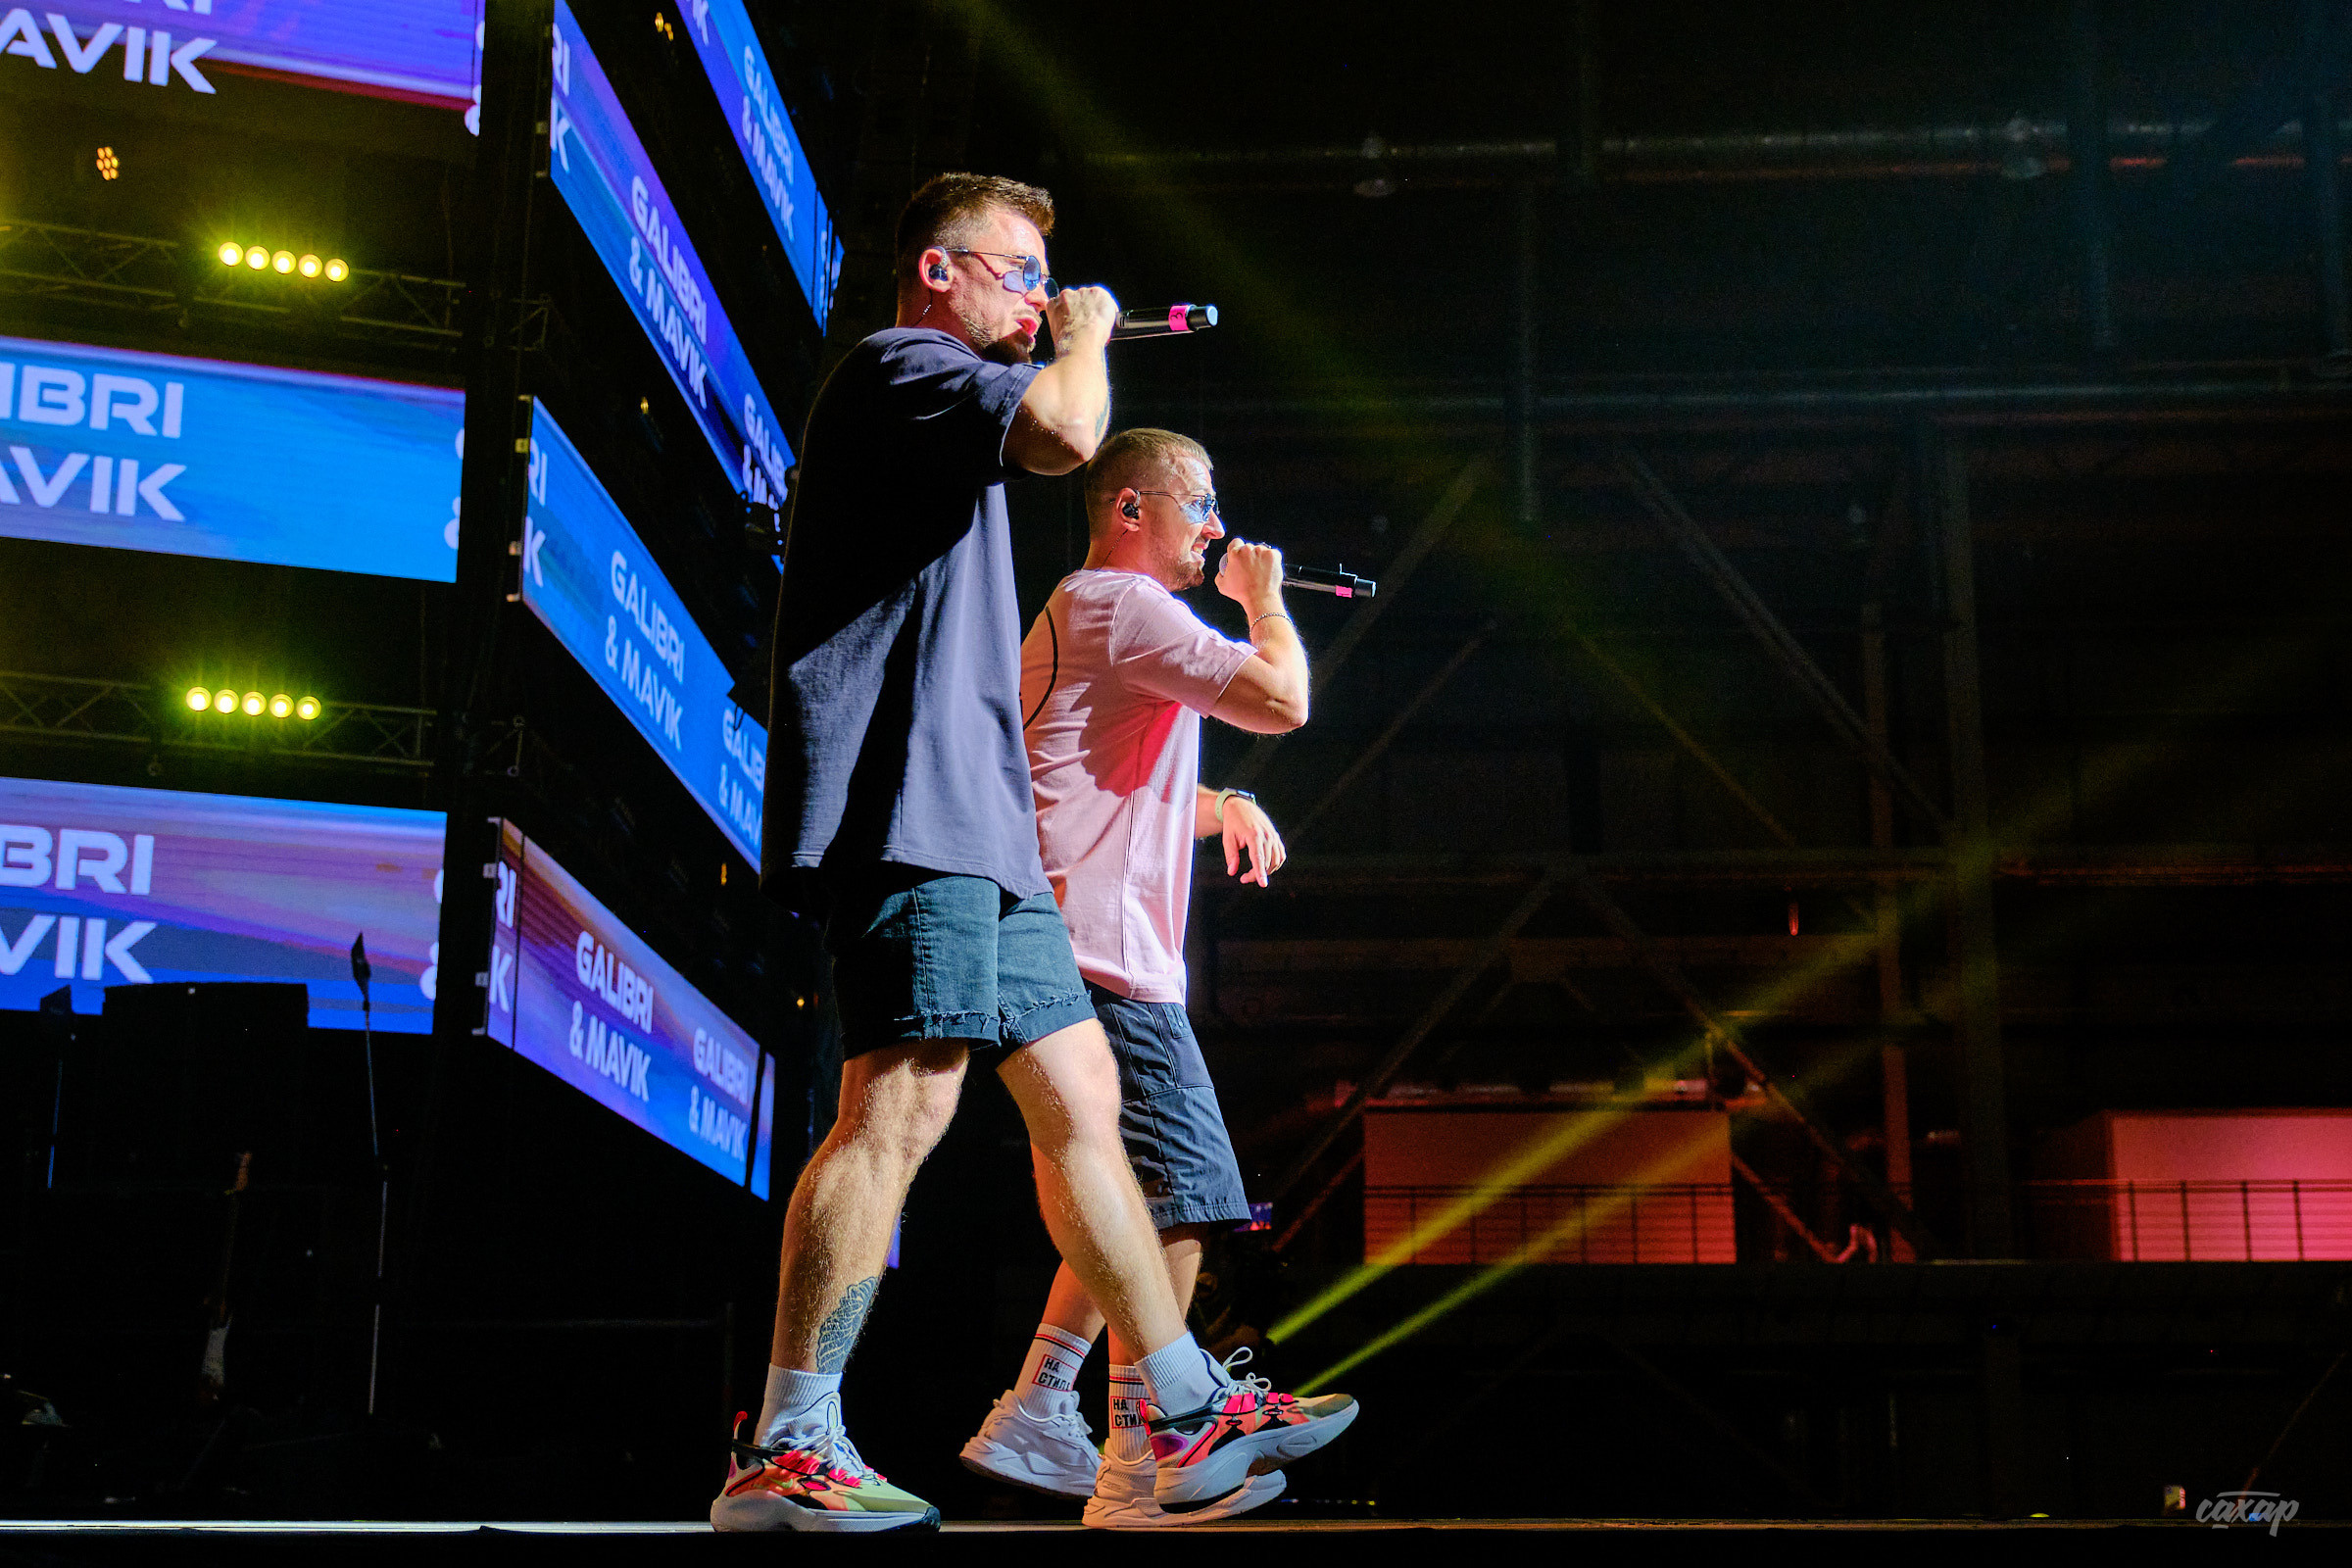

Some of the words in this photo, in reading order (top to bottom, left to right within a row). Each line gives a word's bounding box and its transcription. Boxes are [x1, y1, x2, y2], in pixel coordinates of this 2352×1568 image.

[632, 174, 708, 345] GALIBRI
[646, 268, 708, 410] MAVIK
[611, 550, 684, 685] GALIBRI
[605, 614, 619, 672] &
[620, 638, 683, 752] MAVIK
[576, 930, 654, 1035] GALIBRI
[568, 1000, 584, 1061] &
[585, 1015, 652, 1102] MAVIK
[693, 1026, 751, 1106] GALIBRI
[700, 1094, 748, 1163] MAVIK
[1044, 1357, 1059, 1373] НА
[1113, 1398, 1128, 1411] НА
